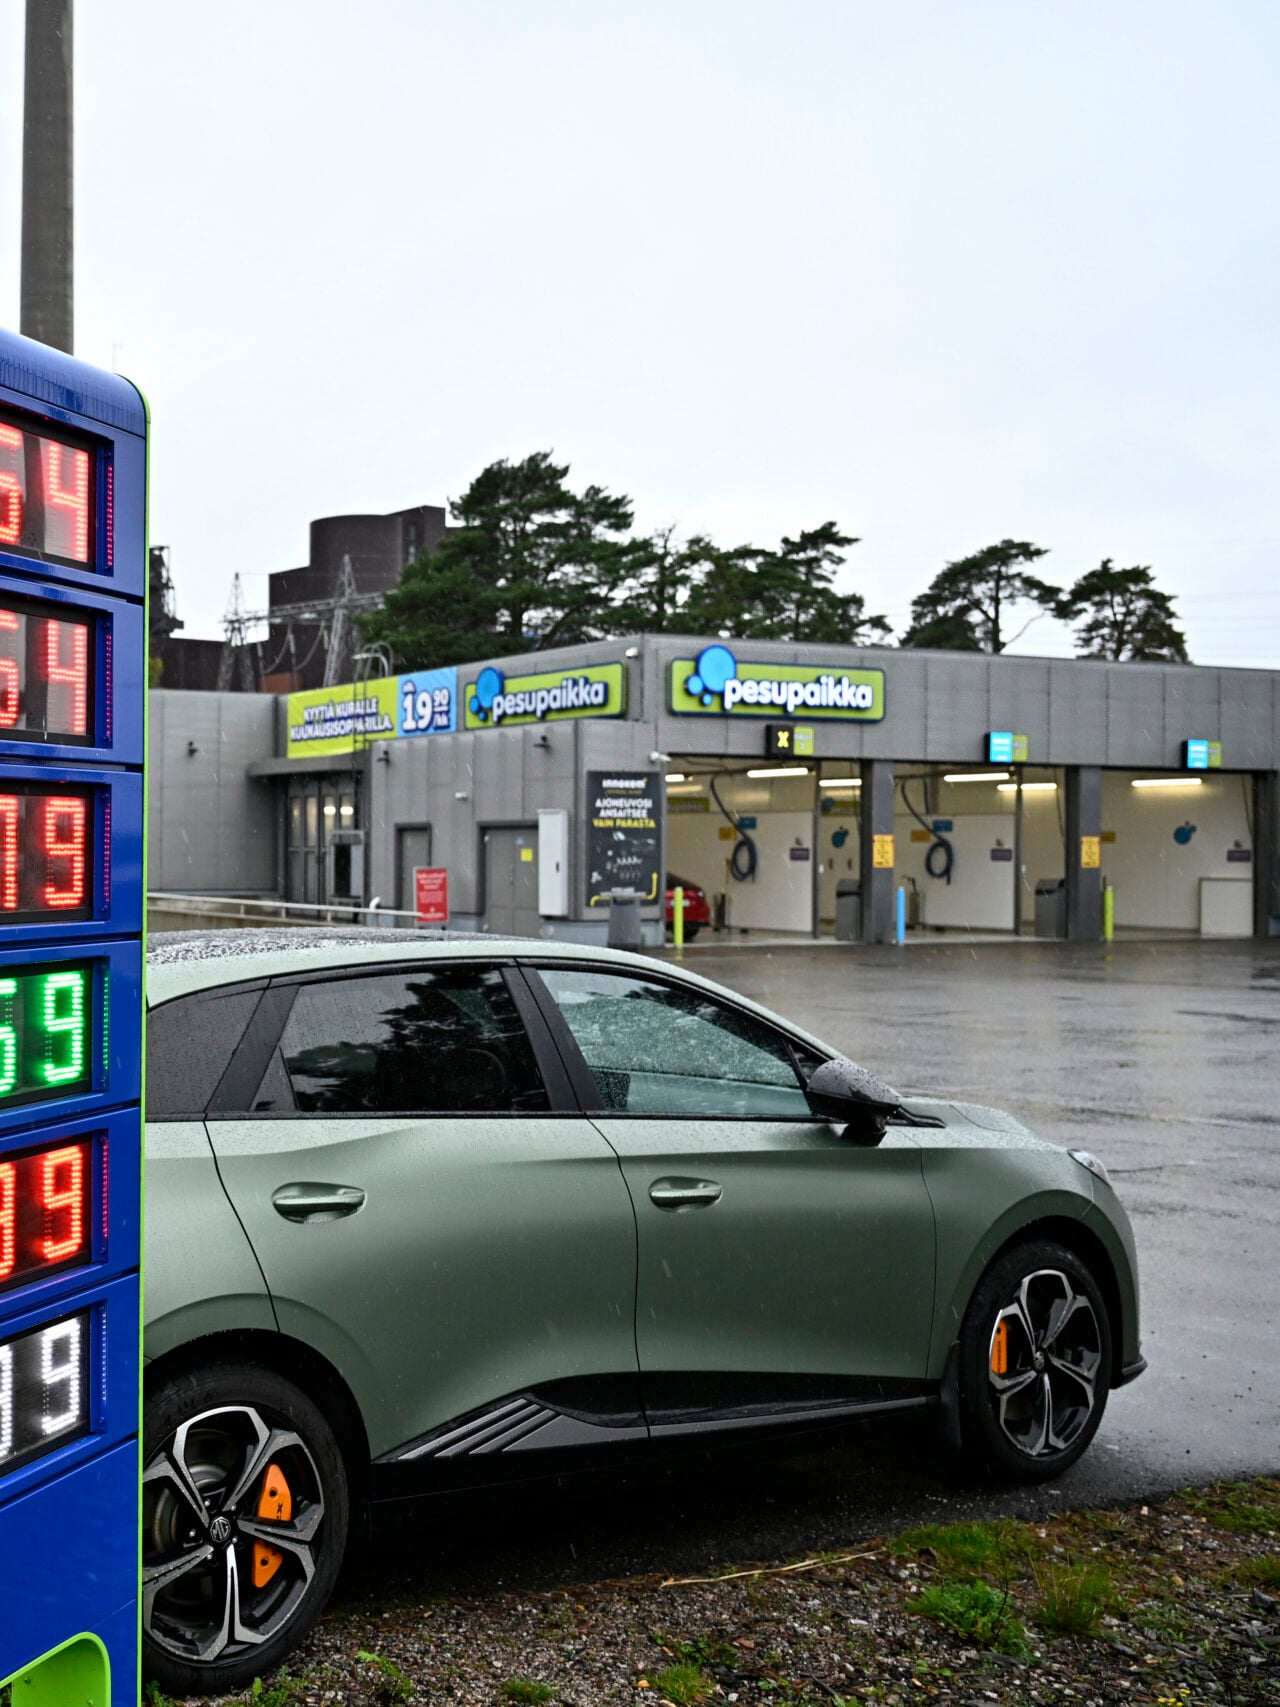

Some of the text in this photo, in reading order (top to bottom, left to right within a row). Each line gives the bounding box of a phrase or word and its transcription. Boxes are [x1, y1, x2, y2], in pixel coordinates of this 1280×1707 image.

[402, 691, 432, 730] 19
[493, 677, 605, 722] pesupaikka
[724, 675, 873, 713] pesupaikka
[211, 1518, 230, 1541] MG
